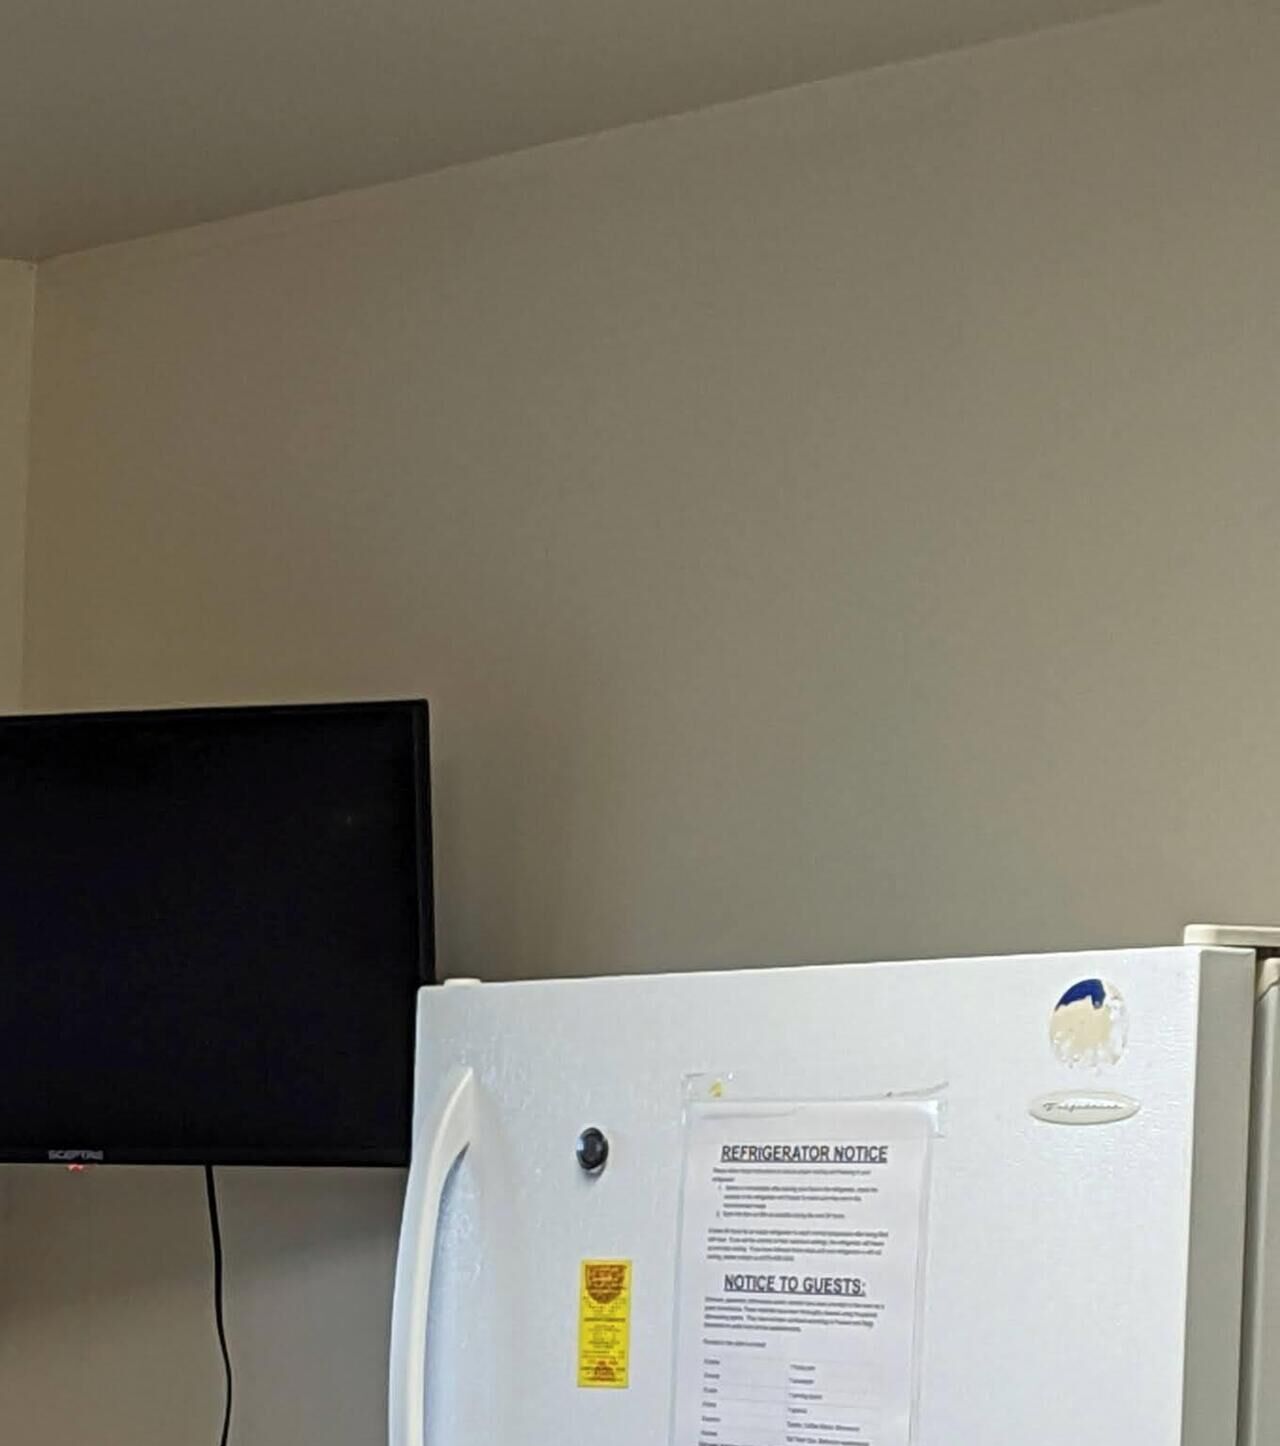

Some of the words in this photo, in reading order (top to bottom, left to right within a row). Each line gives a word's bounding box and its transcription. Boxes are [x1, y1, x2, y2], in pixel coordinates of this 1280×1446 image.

[721, 1145, 830, 1163] REFRIGERATOR
[833, 1145, 889, 1163] NOTICE
[724, 1274, 775, 1293] NOTICE
[780, 1276, 799, 1294] TO
[803, 1277, 867, 1296] GUESTS:
